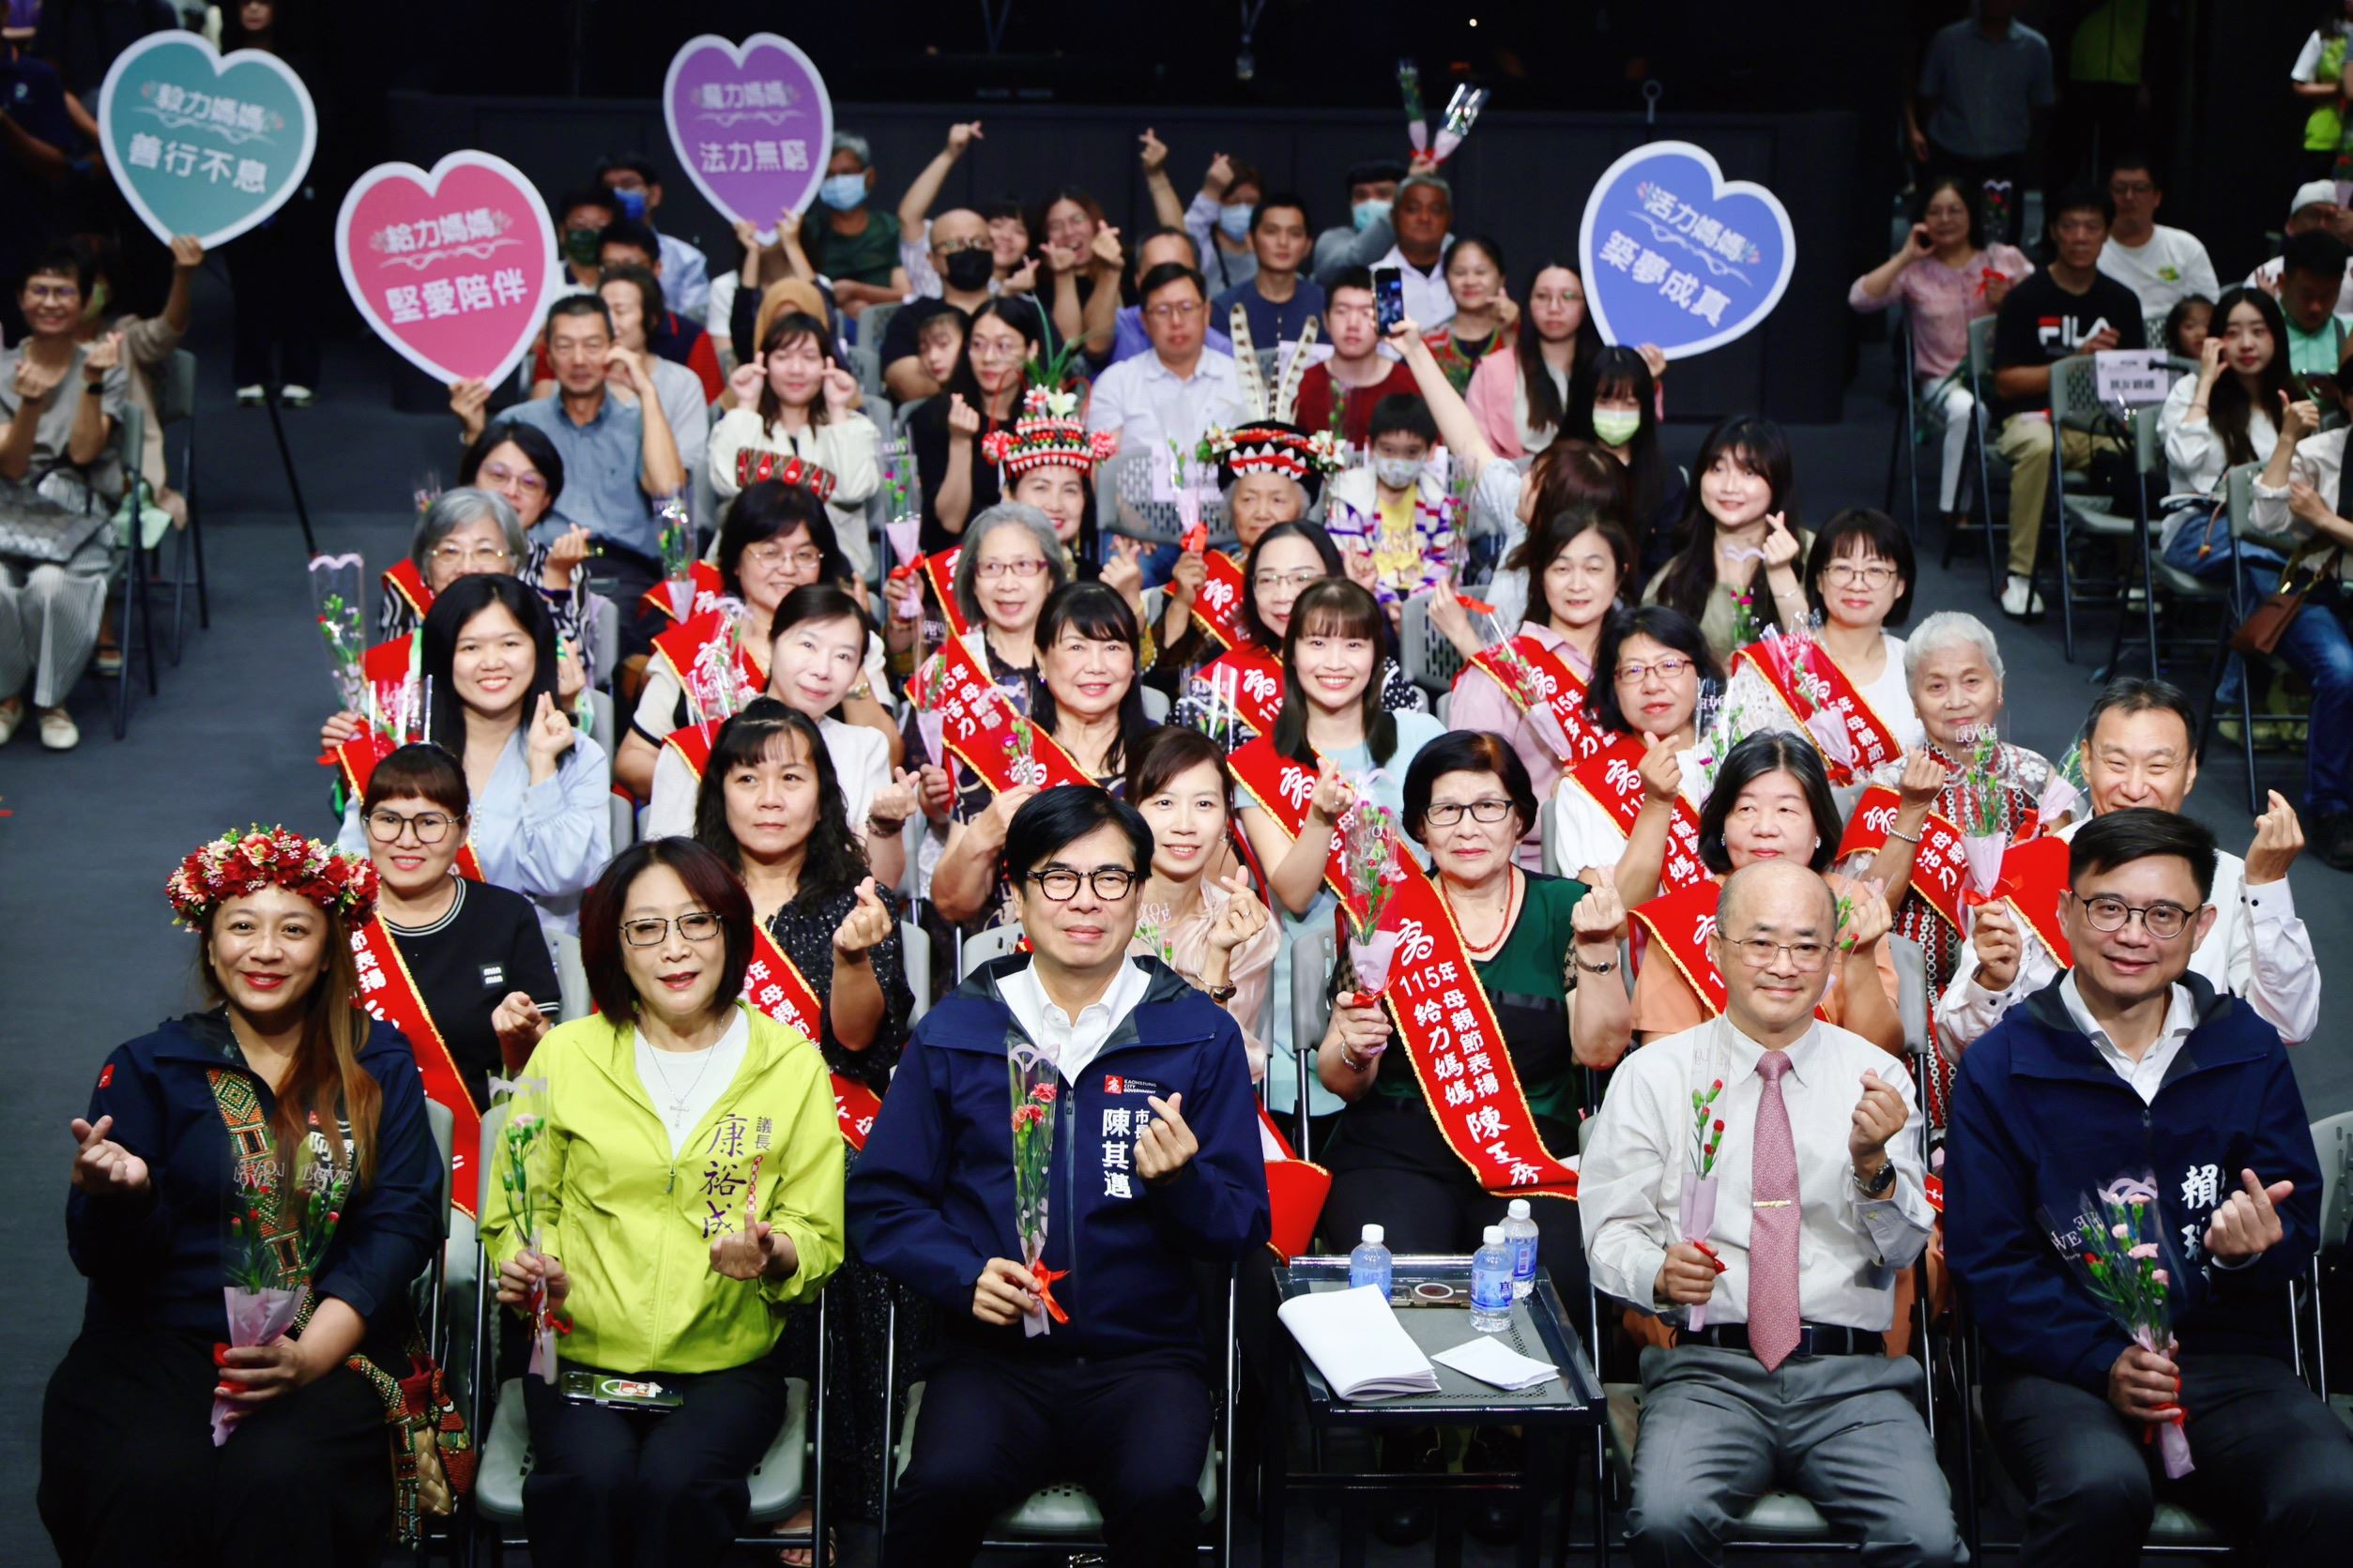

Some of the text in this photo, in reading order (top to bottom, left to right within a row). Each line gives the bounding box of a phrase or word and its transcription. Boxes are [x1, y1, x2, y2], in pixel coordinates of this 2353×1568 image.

[129, 131, 267, 193] 善行不息
[386, 207, 496, 254] 給力媽媽
[1644, 186, 1748, 264] 活力媽媽
[1598, 230, 1732, 327] 築夢成真
[2038, 314, 2111, 349] FILA
[1551, 689, 1584, 716] 15年
[1917, 847, 1958, 891] 活力
[1398, 960, 1459, 997] 115年
[1413, 997, 1475, 1108] 給力媽媽
[1443, 988, 1501, 1097] 母親節表揚
[755, 1116, 773, 1151] 議長
[1102, 1107, 1133, 1199] 陳其邁
[699, 1113, 748, 1240] 康裕成
